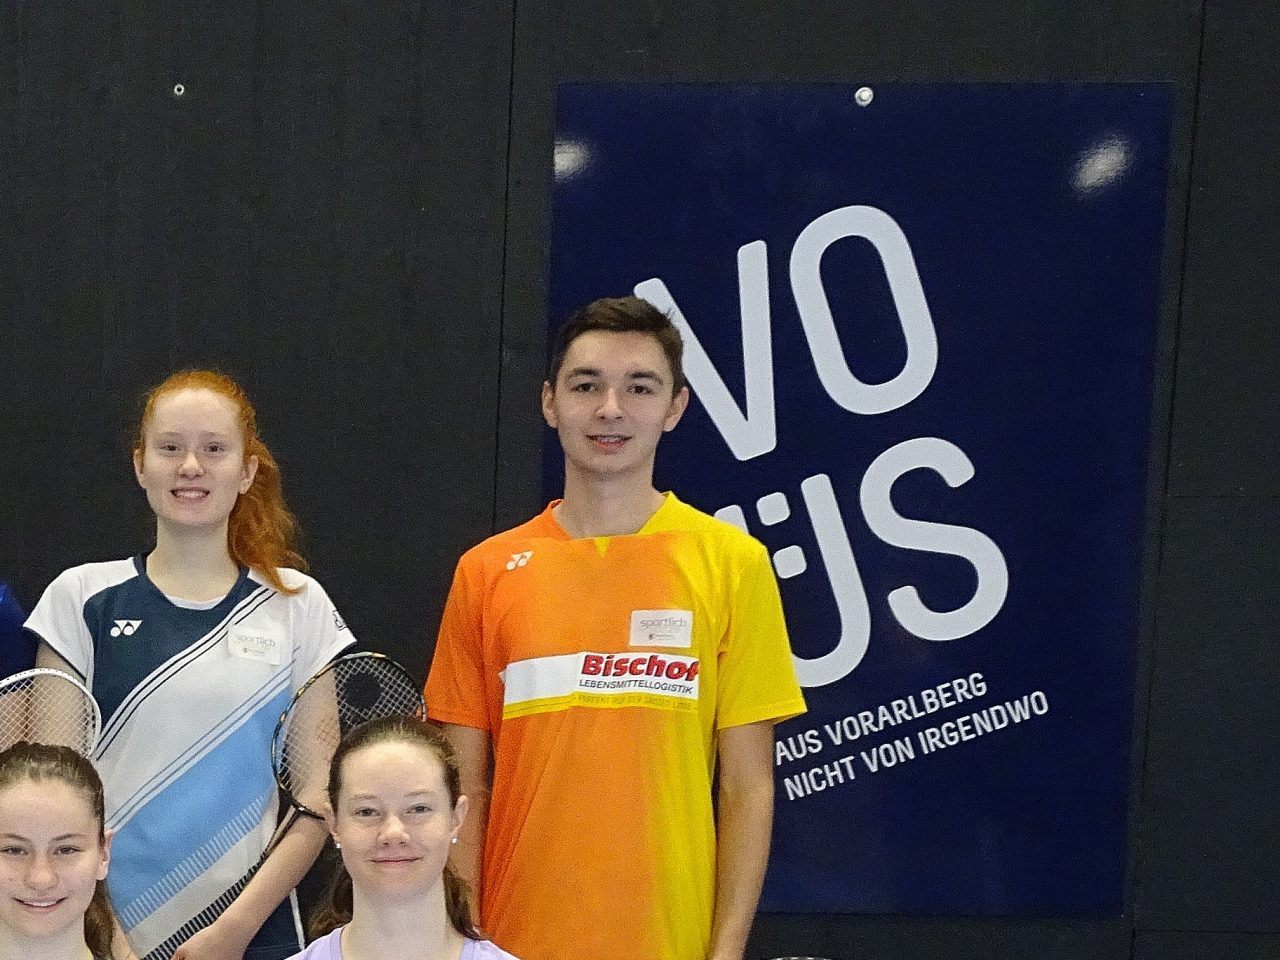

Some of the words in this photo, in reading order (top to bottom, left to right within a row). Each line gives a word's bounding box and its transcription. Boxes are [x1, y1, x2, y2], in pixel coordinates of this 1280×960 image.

[634, 205, 938, 461] VO
[579, 679, 694, 695] LEBENSMITTELLOGISTIK
[775, 729, 823, 766] AUS
[825, 672, 987, 746] VORARLBERG
[783, 755, 856, 801] NICHT
[861, 737, 916, 773] VON
[918, 690, 1049, 755] IRGENDWO
